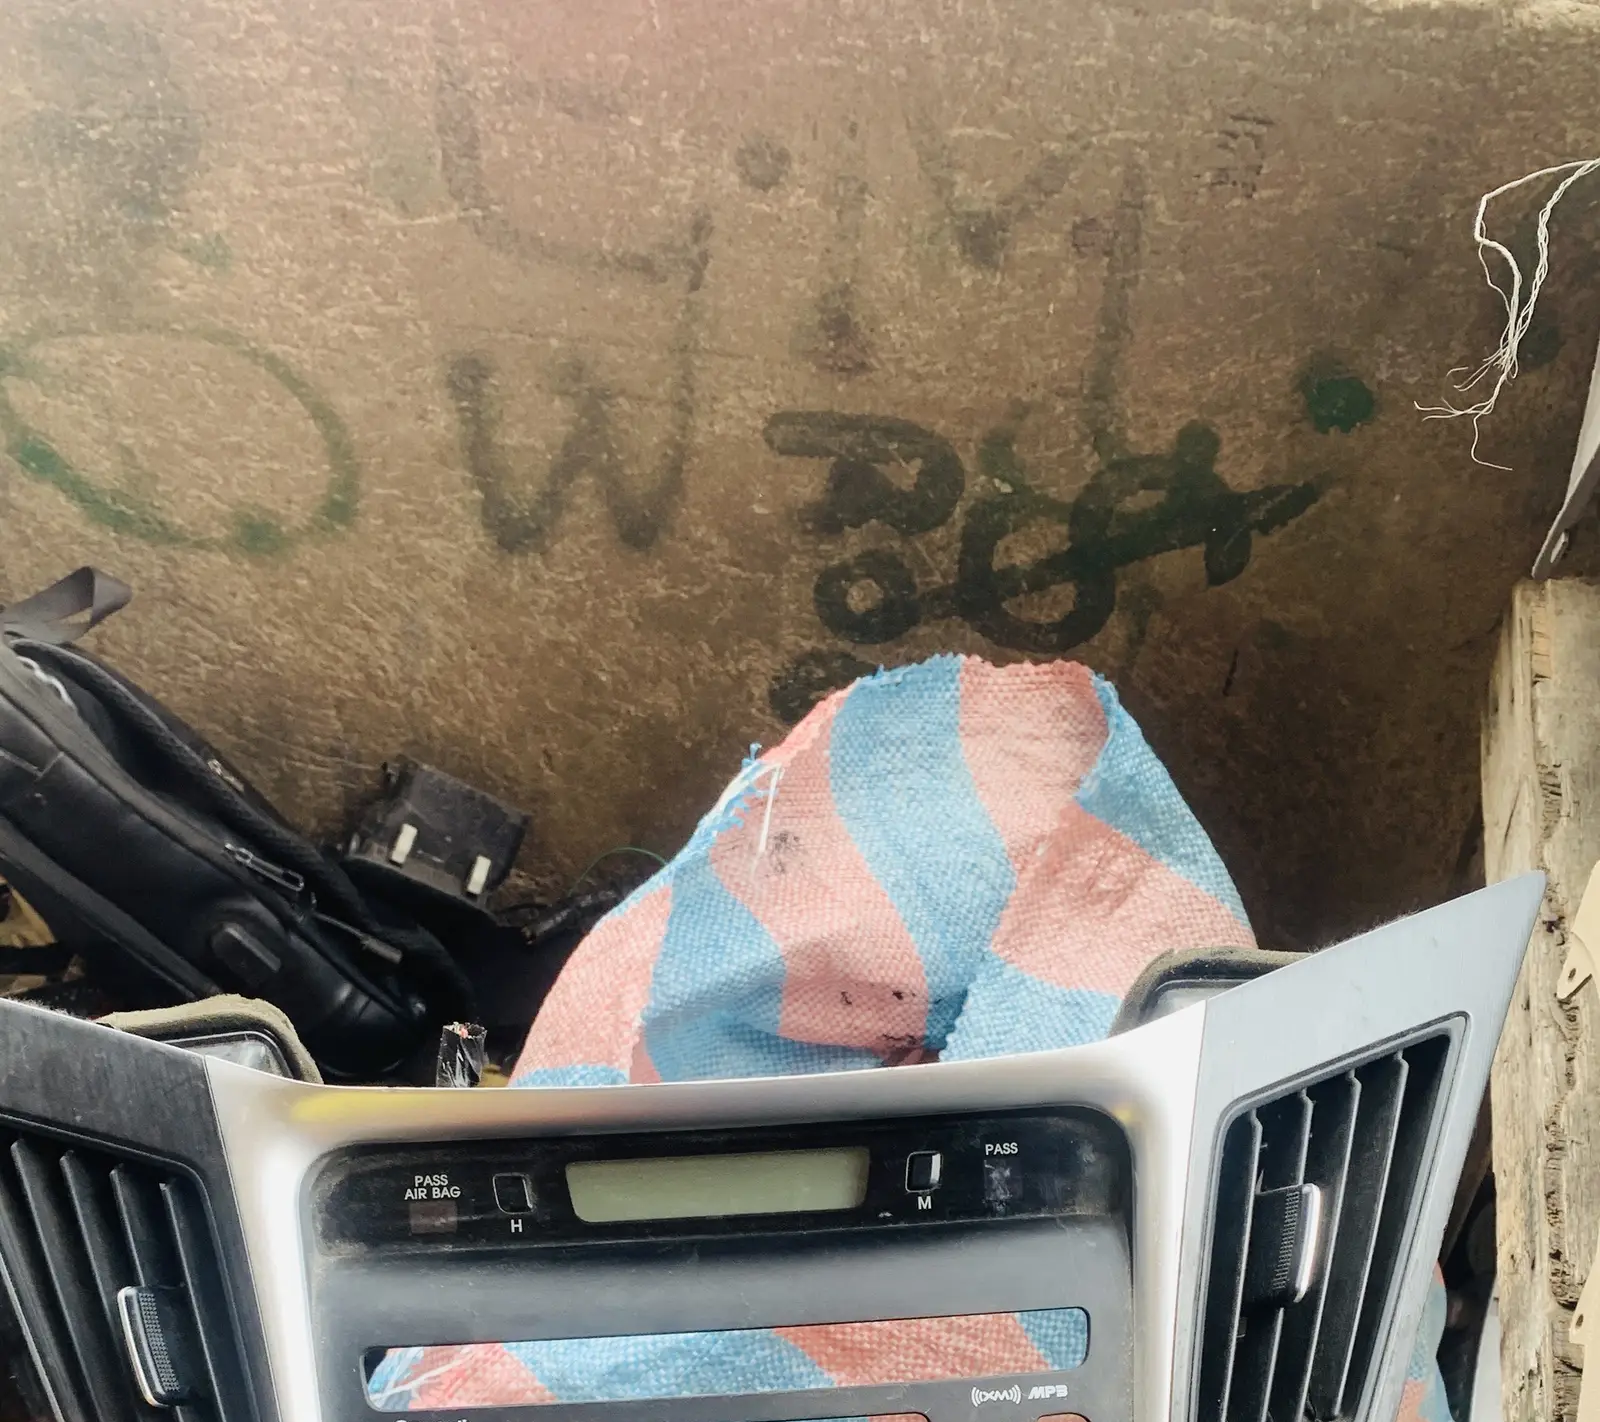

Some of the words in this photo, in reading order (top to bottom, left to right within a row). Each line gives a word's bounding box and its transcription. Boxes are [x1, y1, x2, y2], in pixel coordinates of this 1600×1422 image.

[985, 1141, 1019, 1156] PASS
[414, 1174, 449, 1188] PASS
[404, 1187, 428, 1201] AIR
[431, 1186, 462, 1200] BAG
[917, 1195, 932, 1210] M
[510, 1218, 523, 1233] H
